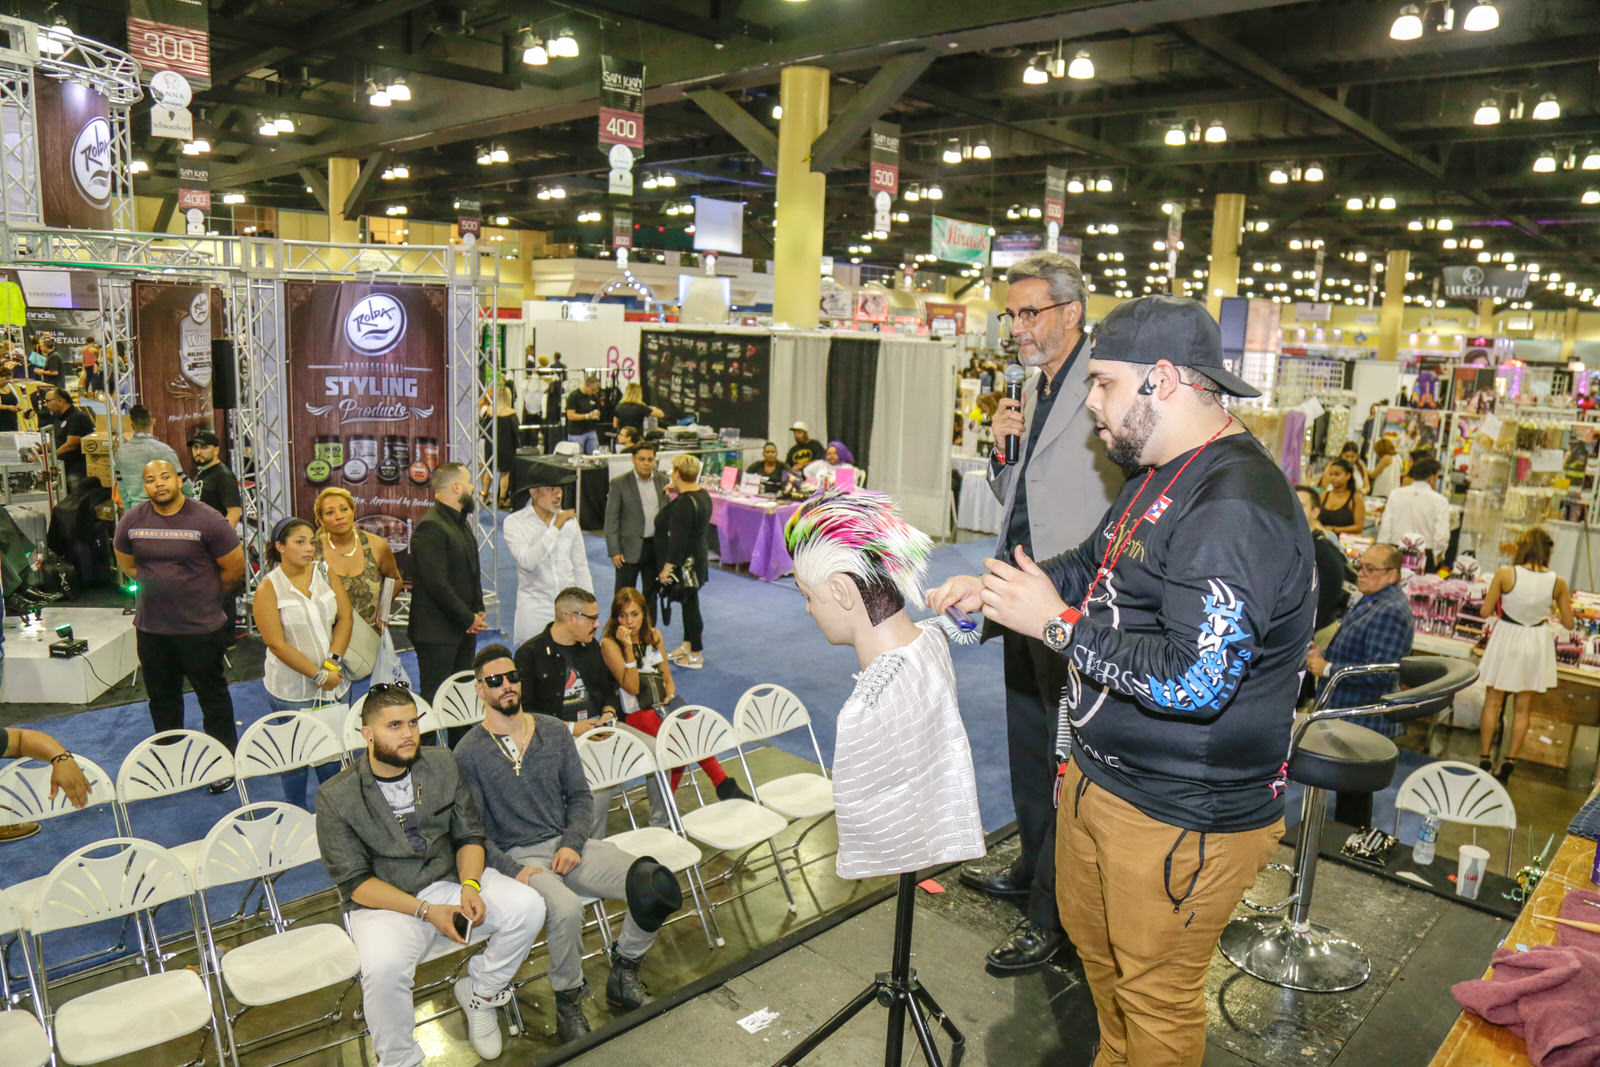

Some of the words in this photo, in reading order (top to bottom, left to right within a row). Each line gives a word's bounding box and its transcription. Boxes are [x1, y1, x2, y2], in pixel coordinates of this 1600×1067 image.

[144, 32, 195, 63] 300
[606, 117, 637, 138] 400
[875, 169, 894, 187] 500
[183, 193, 206, 205] 400
[461, 220, 478, 231] 500
[27, 311, 55, 320] andis
[343, 361, 404, 374] PROFESSIONAL
[325, 375, 418, 398] STYLING
[338, 398, 410, 420] Products
[369, 495, 403, 507] Approved
[402, 497, 411, 508] by
[1209, 649, 1252, 711] FILMS
